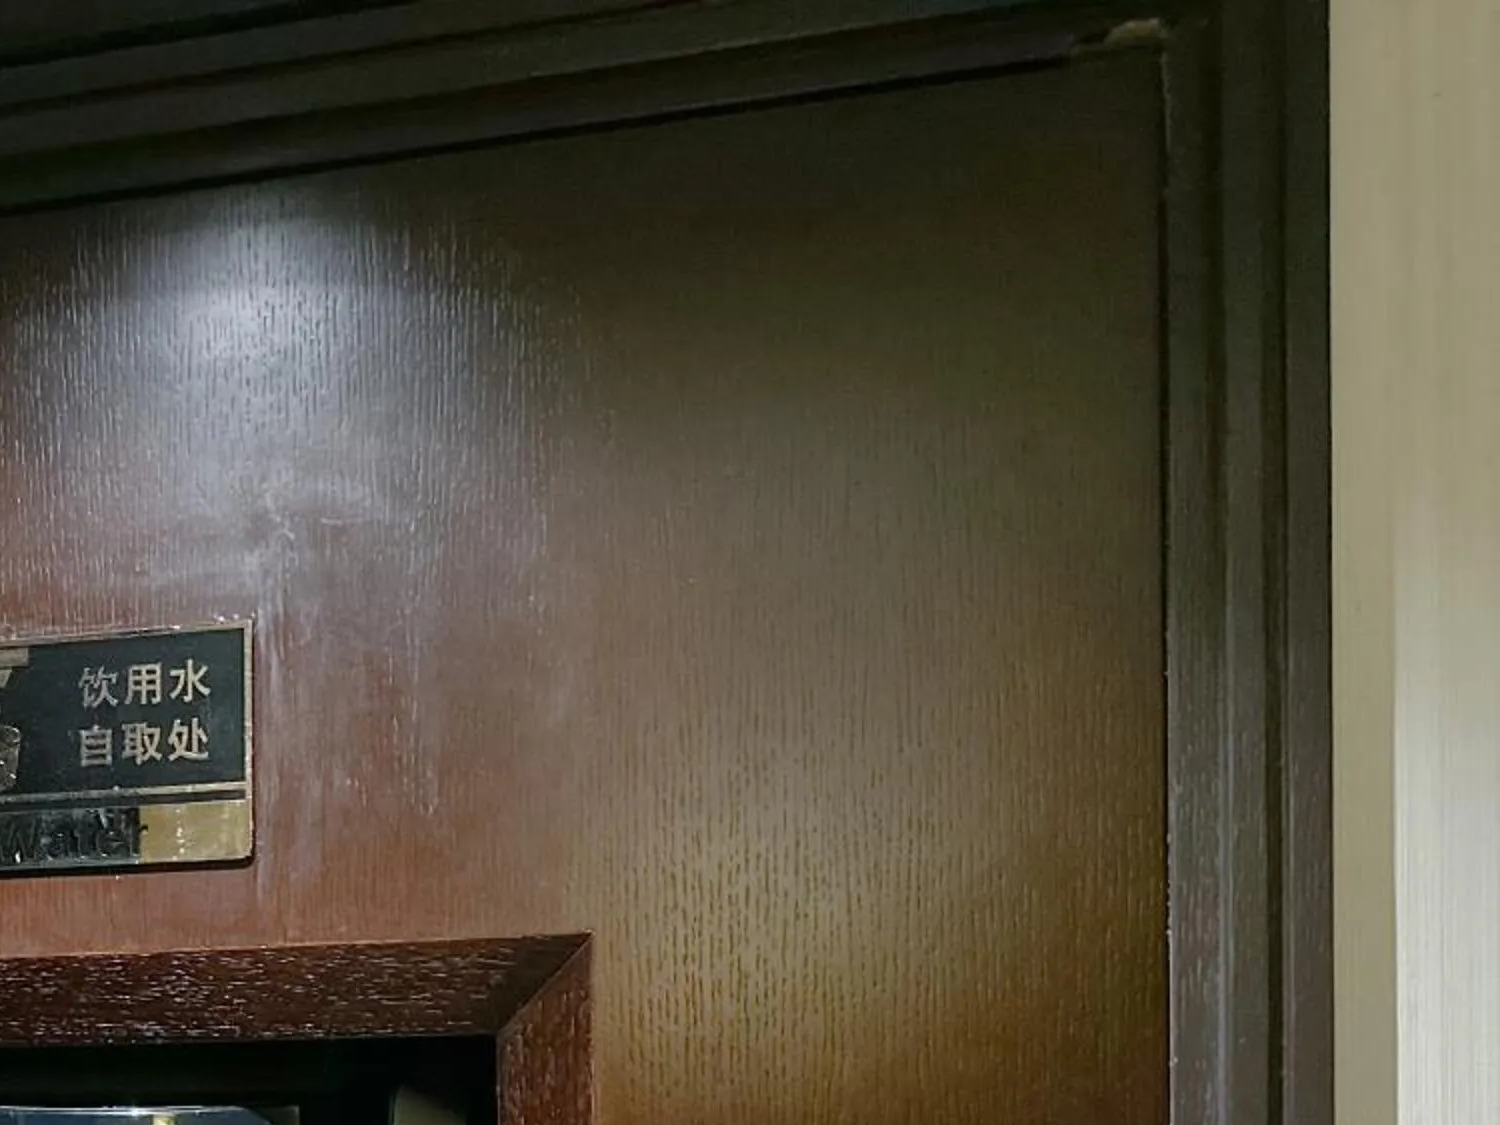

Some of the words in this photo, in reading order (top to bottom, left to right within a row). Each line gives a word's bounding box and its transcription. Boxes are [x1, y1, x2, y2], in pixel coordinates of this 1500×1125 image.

[78, 659, 211, 708] 饮用水
[79, 717, 209, 767] 自取处
